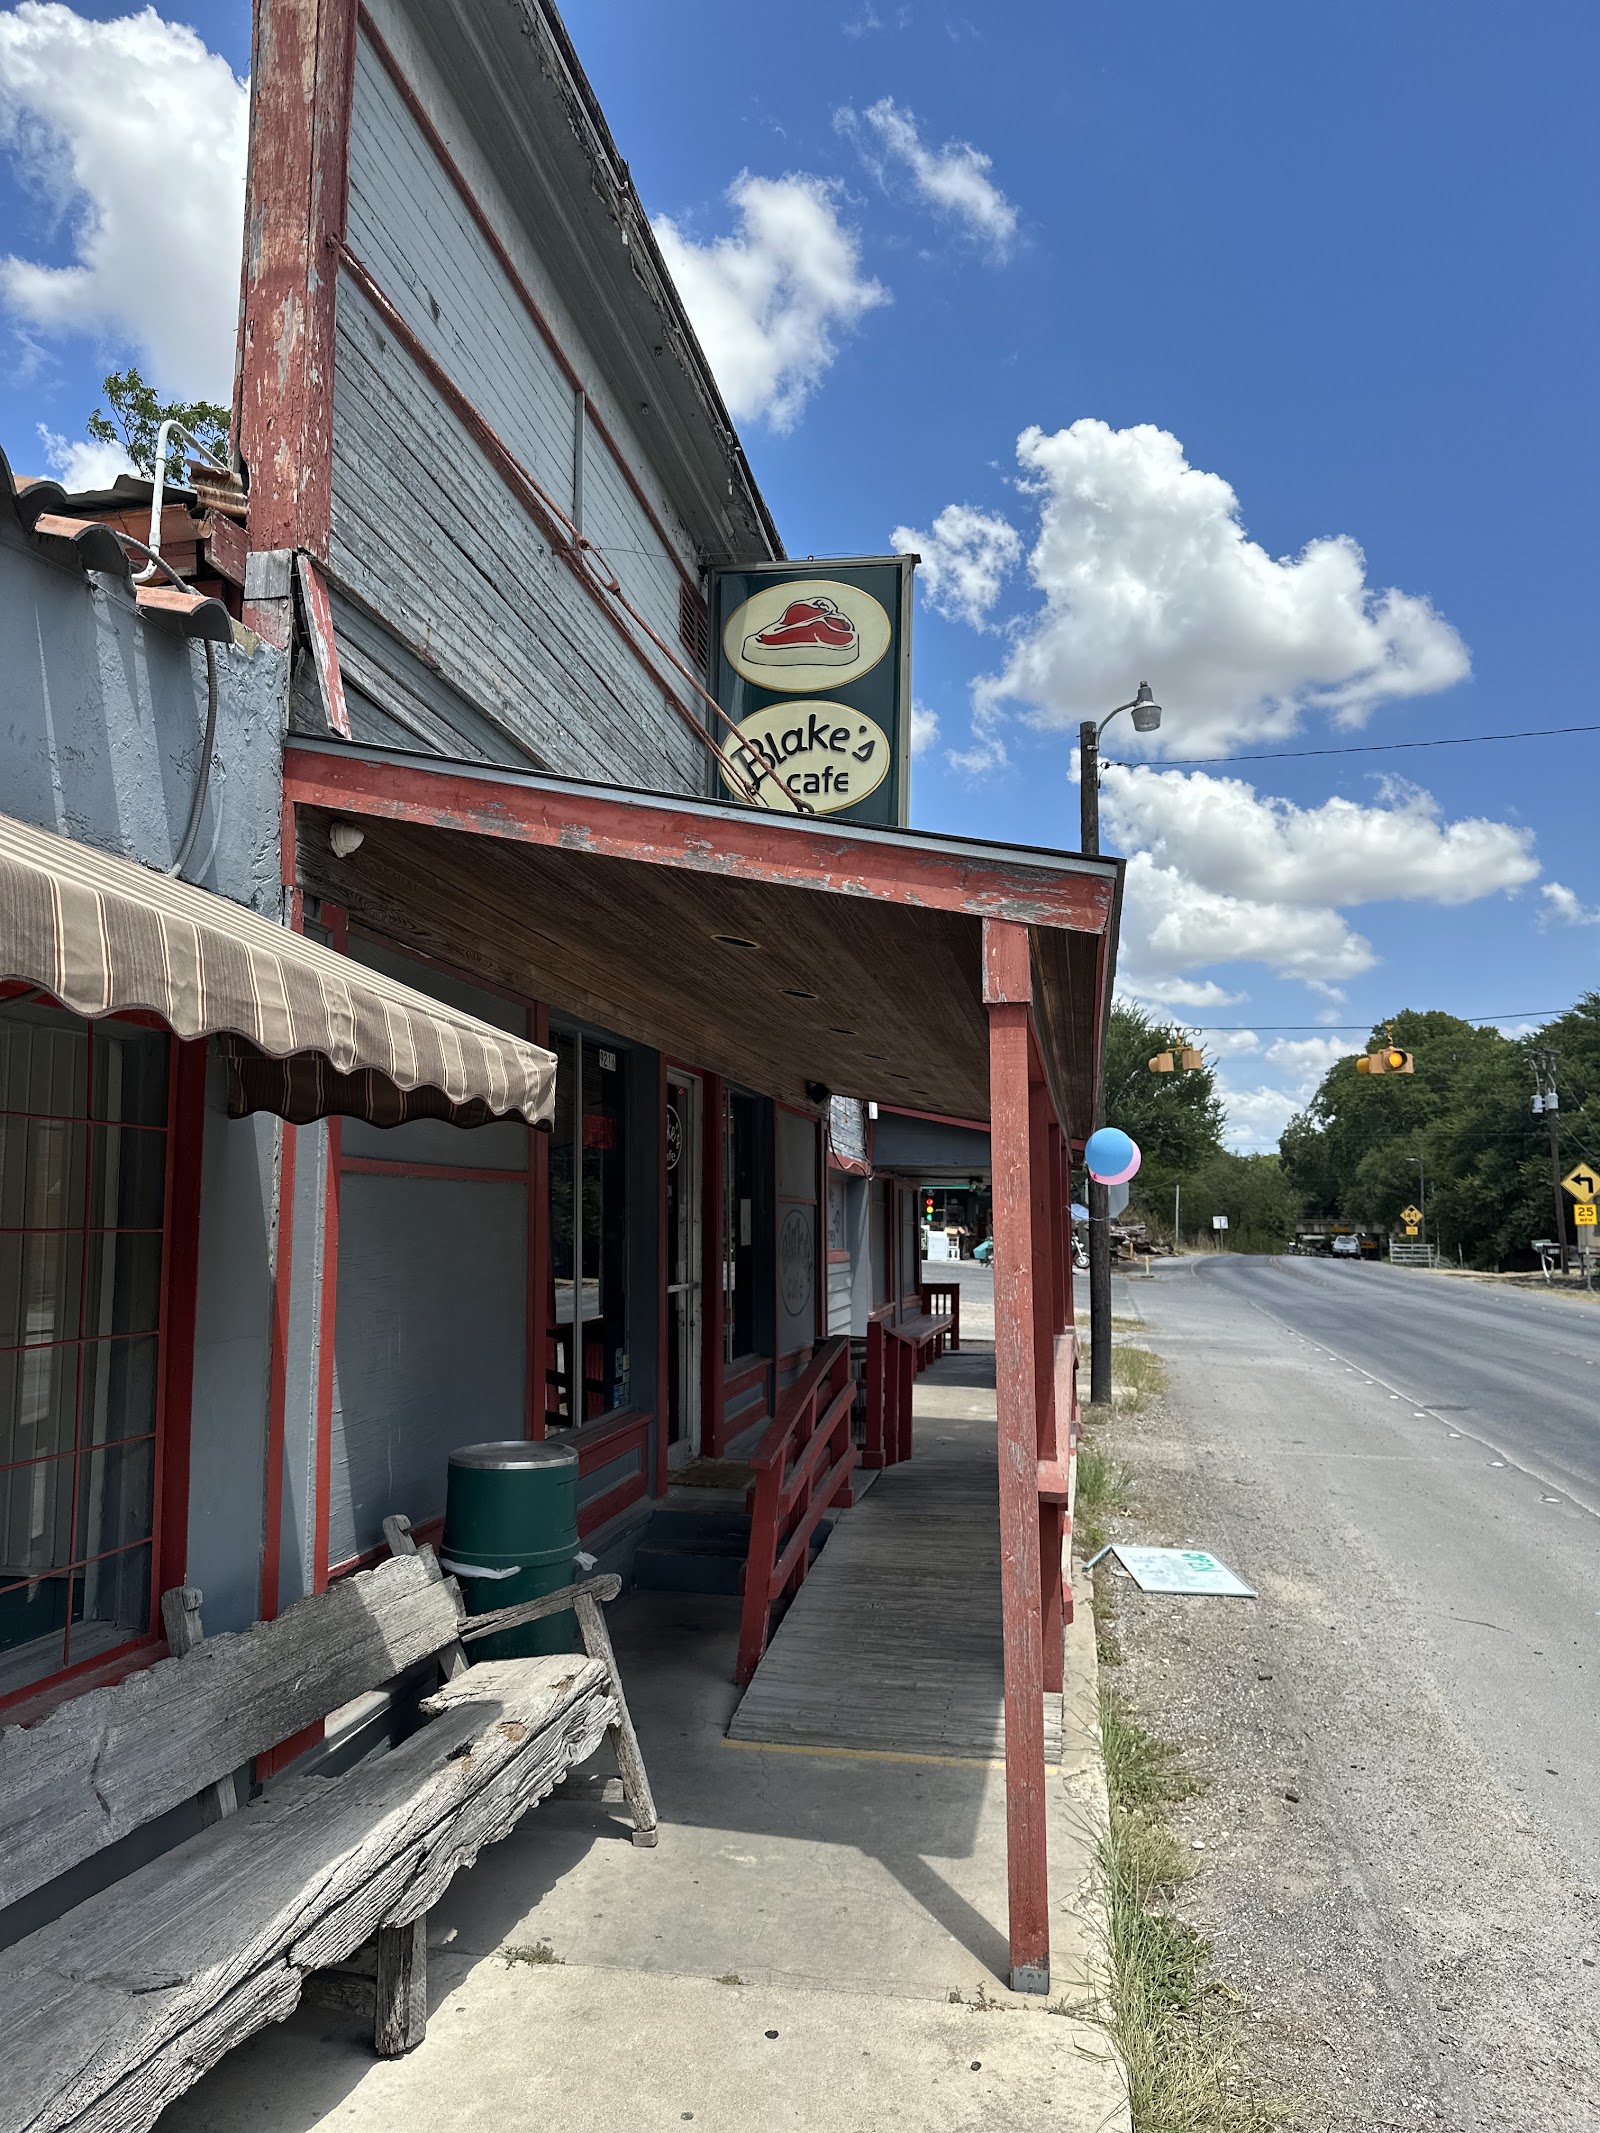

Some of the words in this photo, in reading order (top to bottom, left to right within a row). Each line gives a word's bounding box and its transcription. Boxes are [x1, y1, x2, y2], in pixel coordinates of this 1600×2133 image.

[730, 713, 876, 795] Blake's
[786, 765, 850, 794] cafe
[1578, 1206, 1594, 1216] 25
